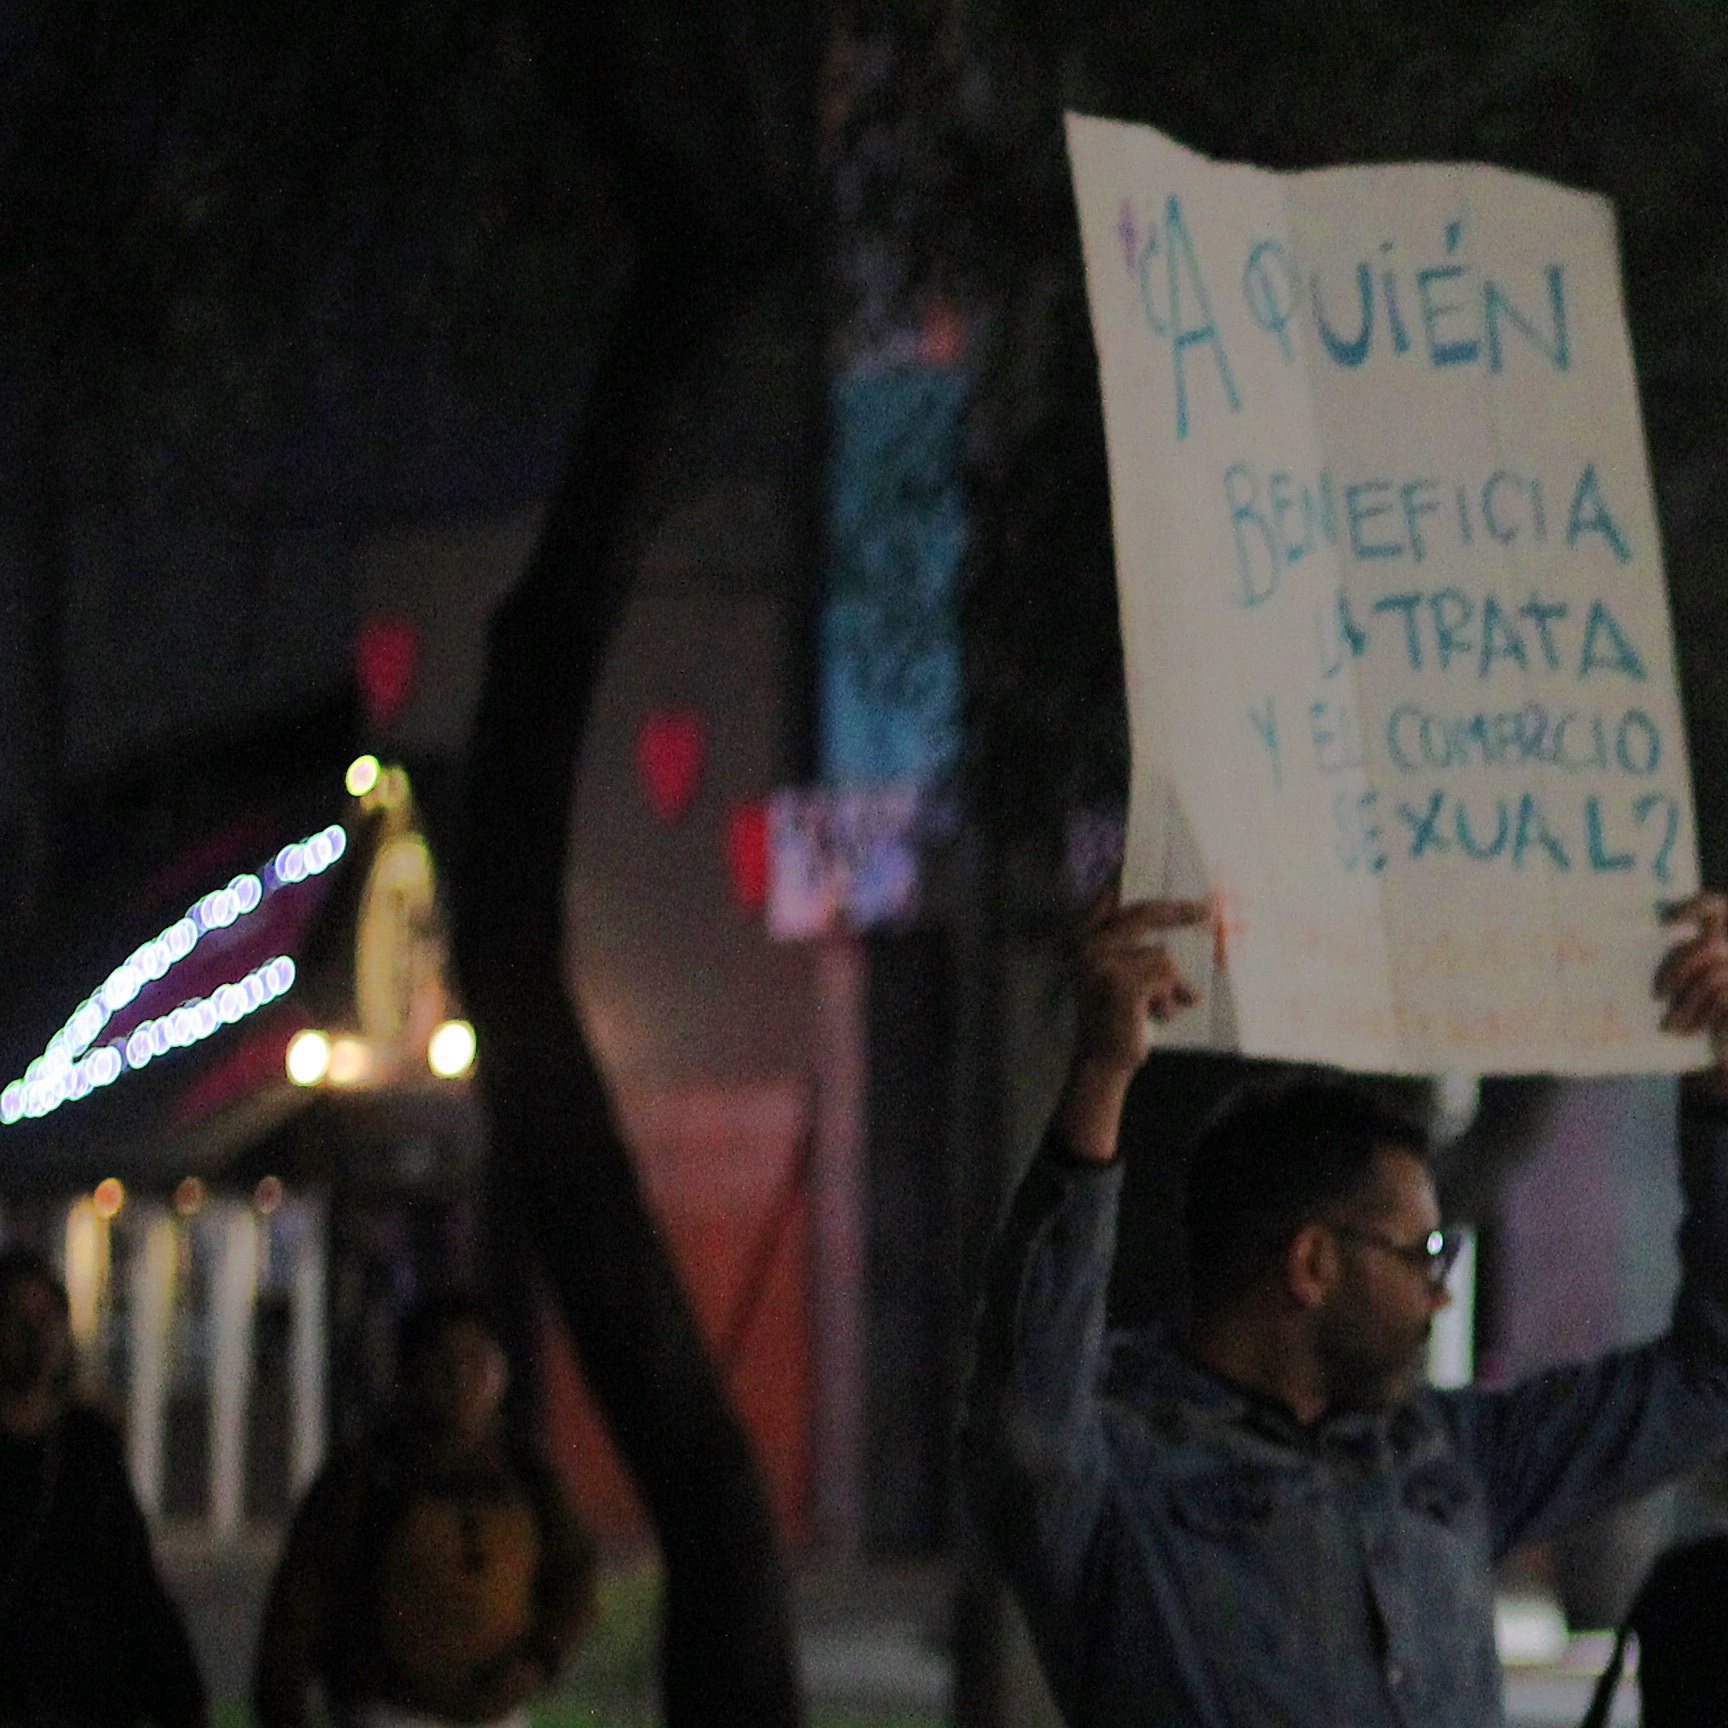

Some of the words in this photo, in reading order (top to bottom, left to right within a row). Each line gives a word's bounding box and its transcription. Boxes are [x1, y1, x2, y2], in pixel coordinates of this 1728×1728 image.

[1222, 458, 1634, 609] BENEFICIA
[1370, 587, 1647, 680] TRATA
[1246, 695, 1285, 792] Y
[1306, 696, 1366, 776] EL
[1384, 700, 1663, 776] COMERCIO
